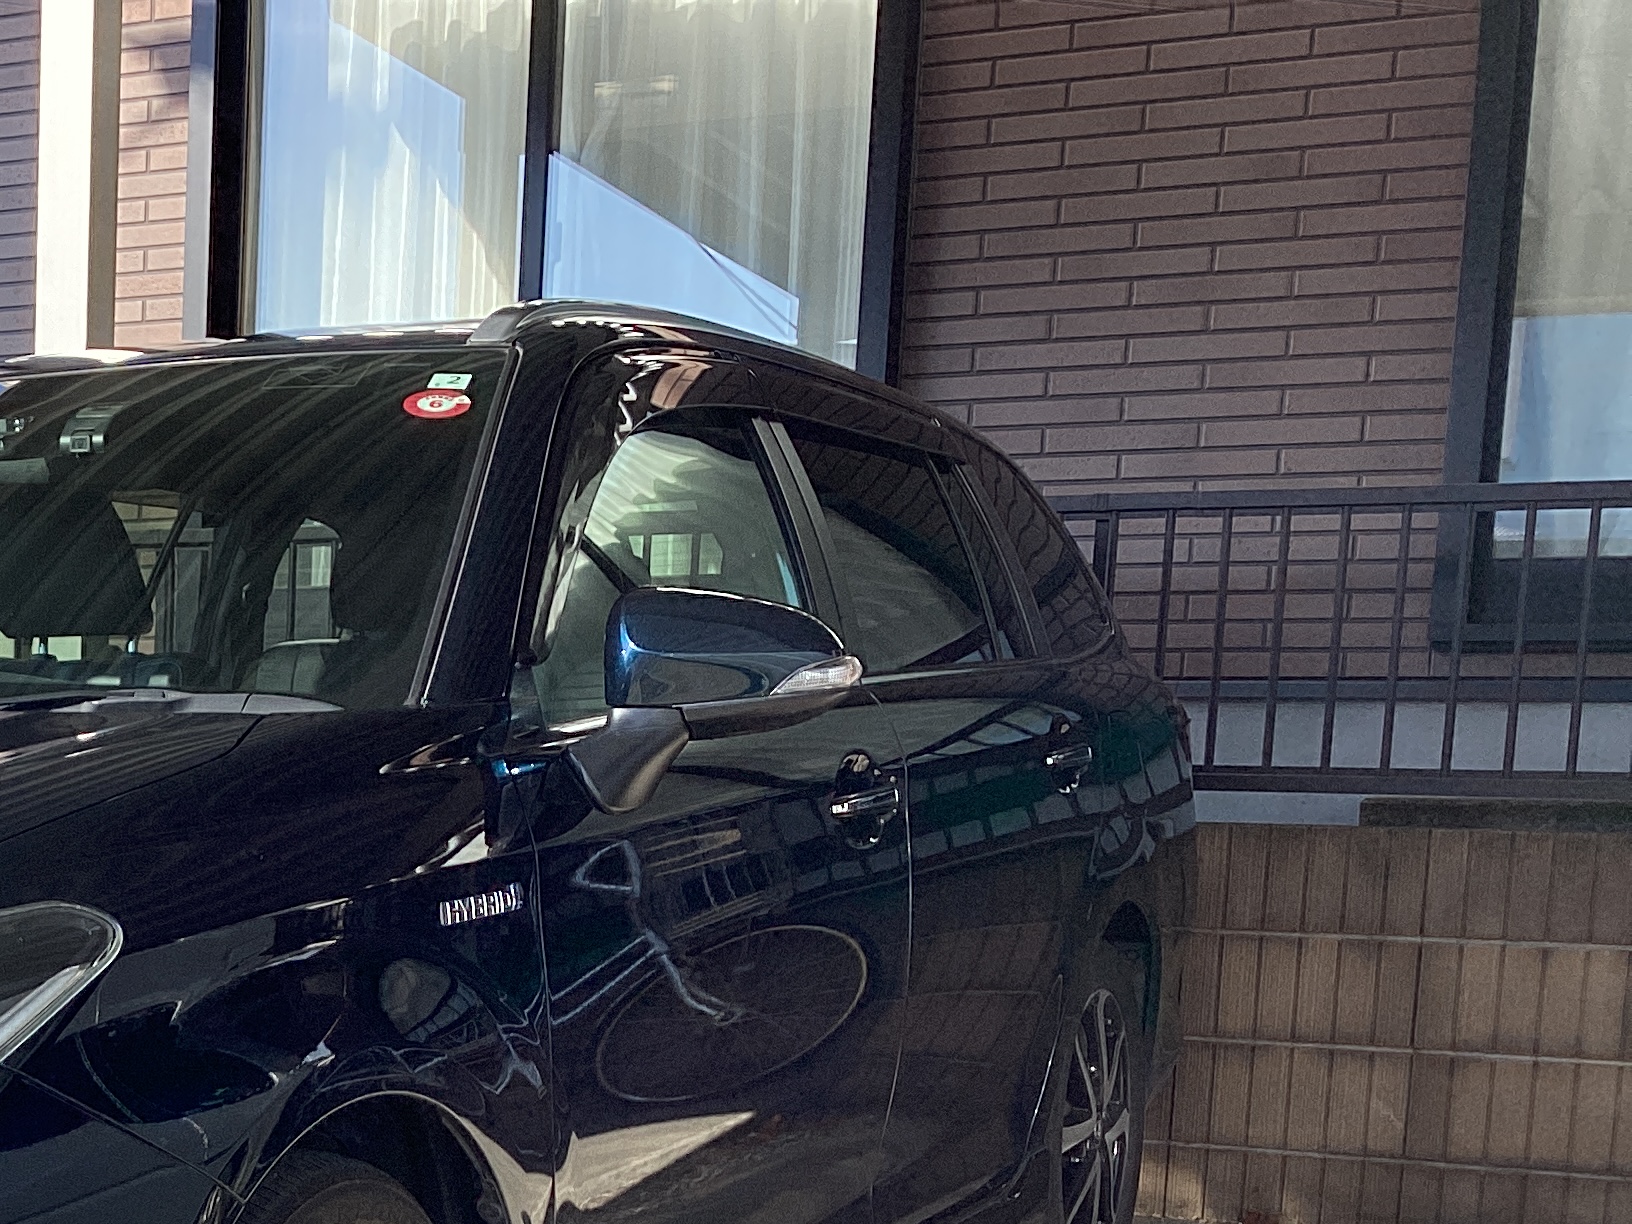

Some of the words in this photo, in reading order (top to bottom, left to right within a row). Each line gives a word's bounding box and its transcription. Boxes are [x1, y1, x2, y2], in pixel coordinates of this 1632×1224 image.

[446, 375, 461, 384] 2
[429, 399, 443, 408] 6
[442, 888, 518, 925] HYBRID
